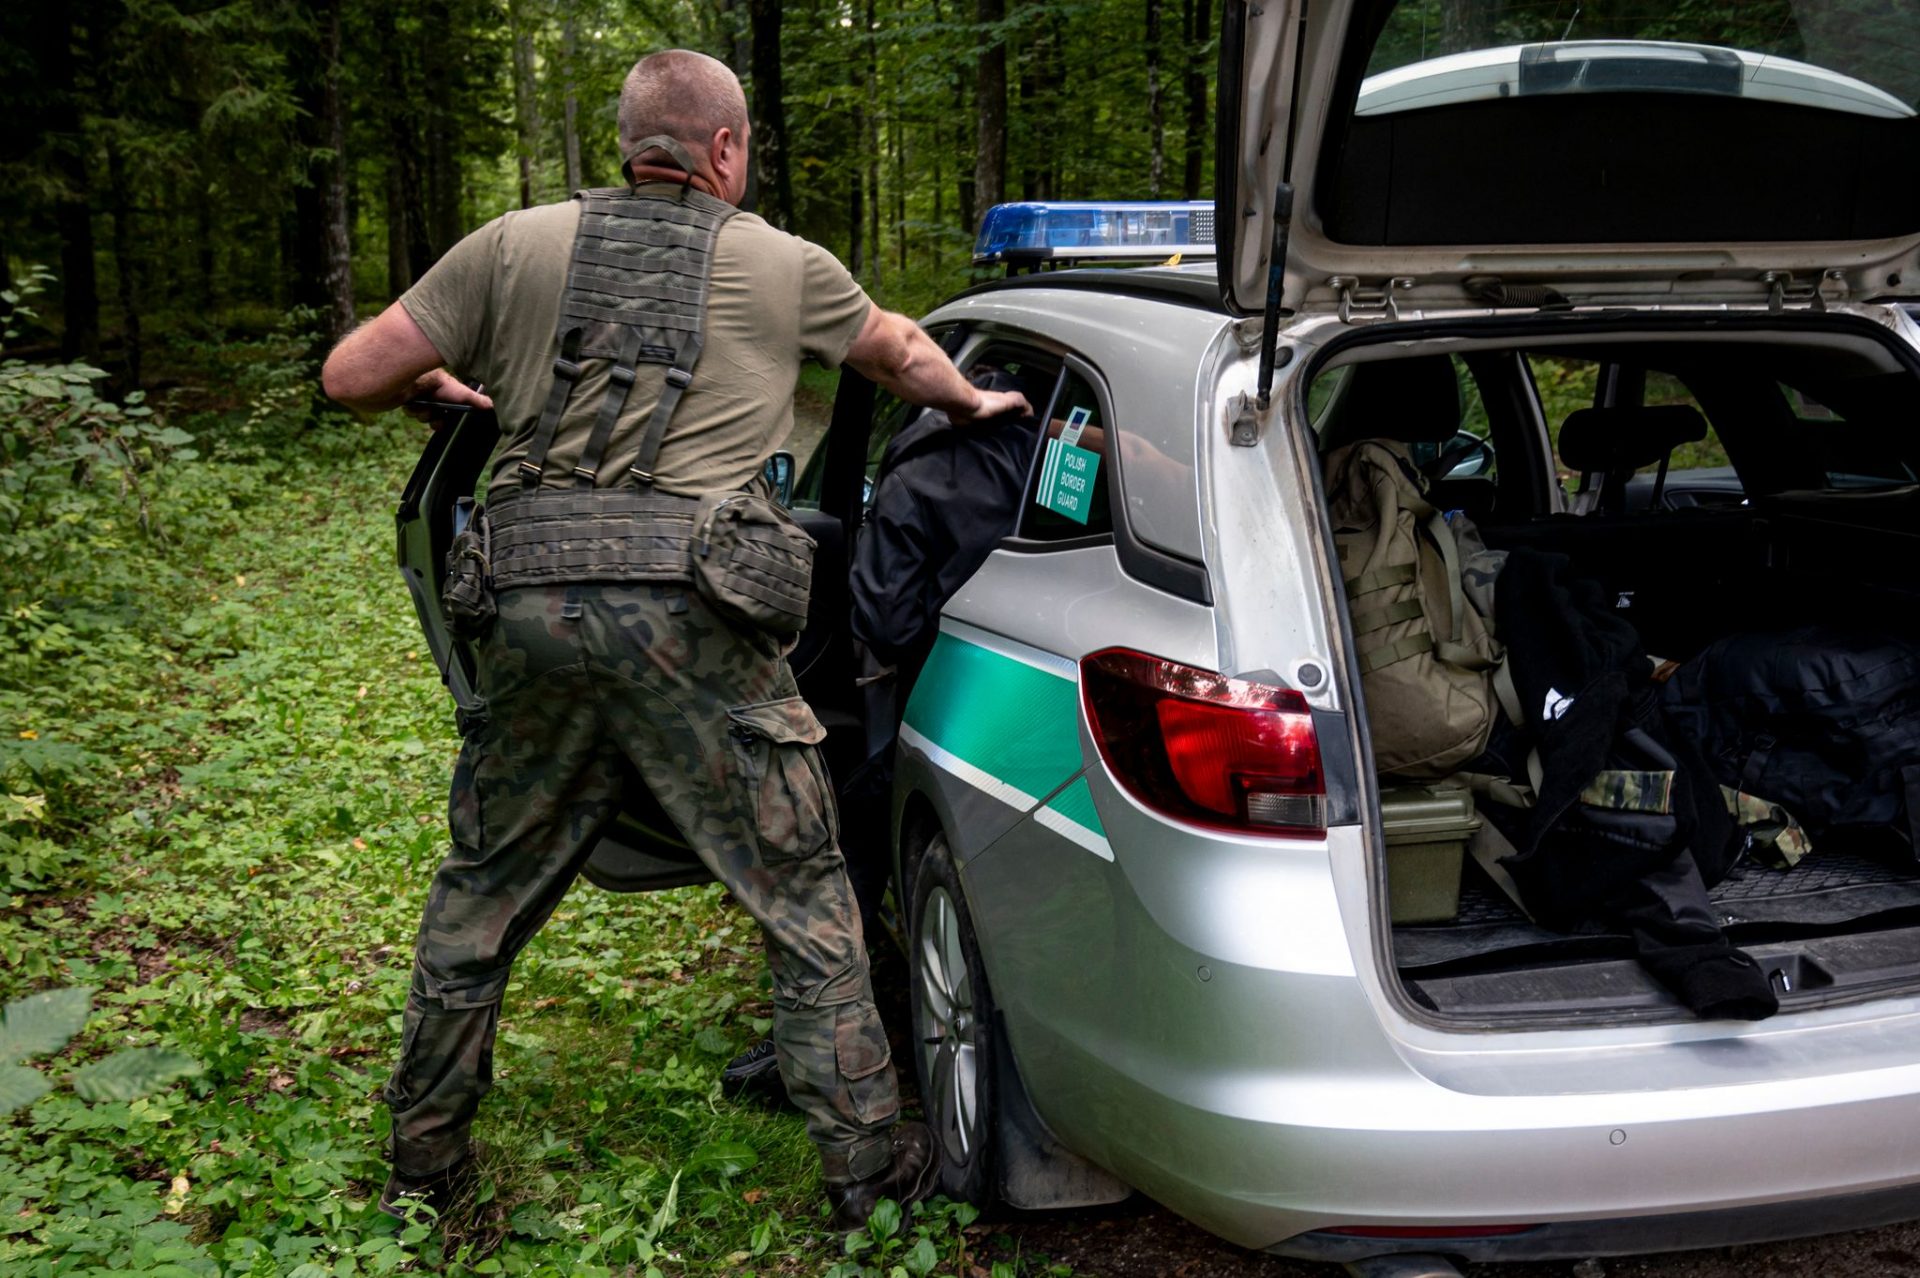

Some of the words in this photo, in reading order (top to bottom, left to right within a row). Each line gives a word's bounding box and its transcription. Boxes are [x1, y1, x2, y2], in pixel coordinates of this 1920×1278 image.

[1064, 453, 1087, 472] POLISH
[1060, 471, 1086, 493] BORDER
[1057, 490, 1078, 511] GUARD
